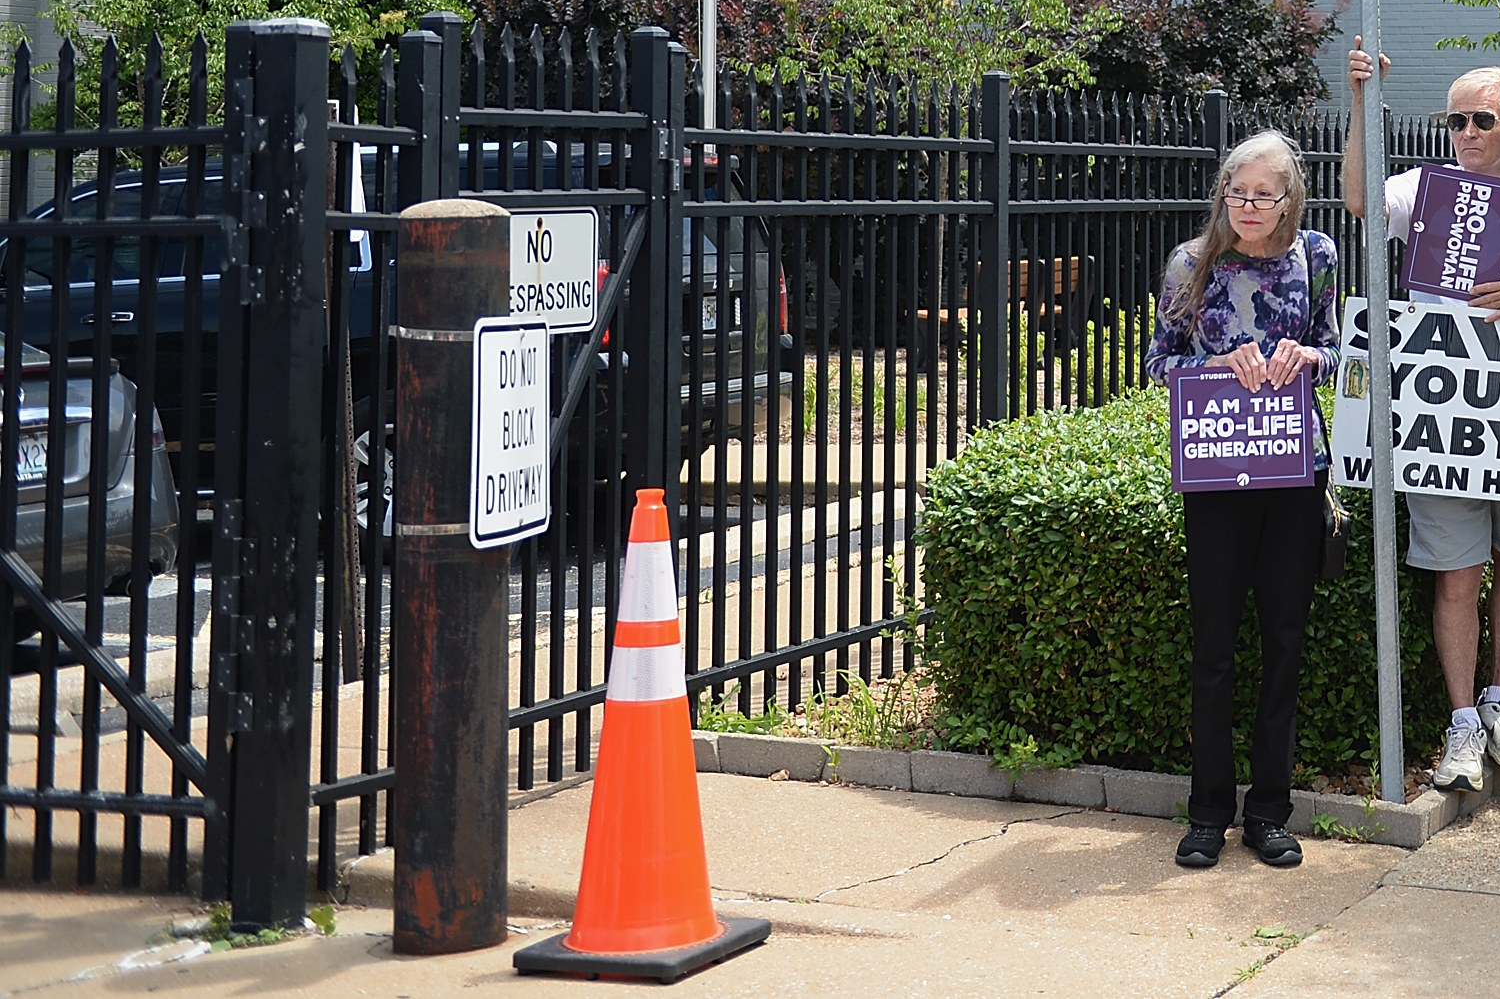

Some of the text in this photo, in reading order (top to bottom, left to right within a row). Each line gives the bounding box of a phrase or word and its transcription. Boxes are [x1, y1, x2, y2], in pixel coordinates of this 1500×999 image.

[527, 230, 552, 263] NO
[1440, 181, 1472, 289] PRO-WOMAN
[1455, 184, 1492, 292] PRO-LIFE
[500, 347, 537, 389] DO NOT
[1186, 396, 1294, 415] I AM THE
[503, 406, 535, 451] BLOCK
[1181, 414, 1302, 440] PRO-LIFE
[1184, 438, 1300, 459] GENERATION
[486, 464, 543, 515] DRIVEWAY
[1402, 462, 1469, 491] CAN
